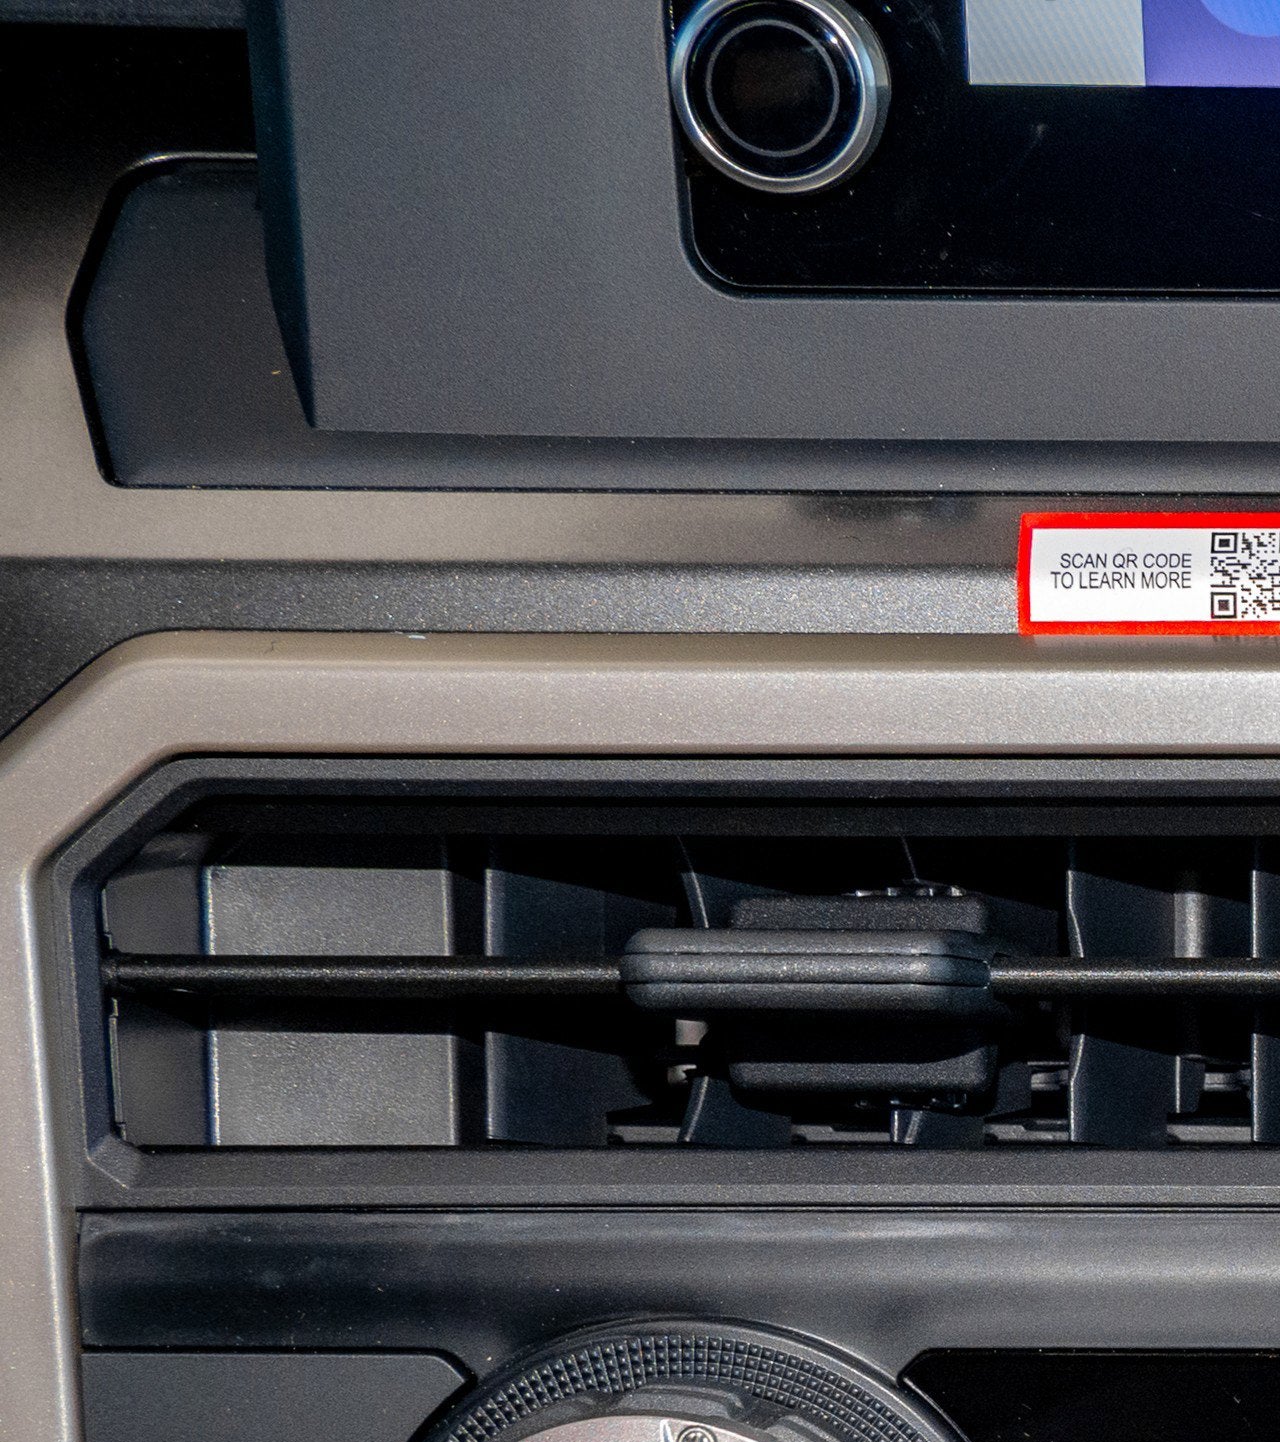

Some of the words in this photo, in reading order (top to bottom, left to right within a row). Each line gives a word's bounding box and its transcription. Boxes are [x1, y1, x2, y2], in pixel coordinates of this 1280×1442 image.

[1060, 552, 1108, 569] SCAN
[1112, 552, 1138, 569] QR
[1142, 552, 1192, 569] CODE
[1050, 571, 1074, 589] TO
[1079, 571, 1135, 589] LEARN
[1141, 571, 1192, 590] MORE
